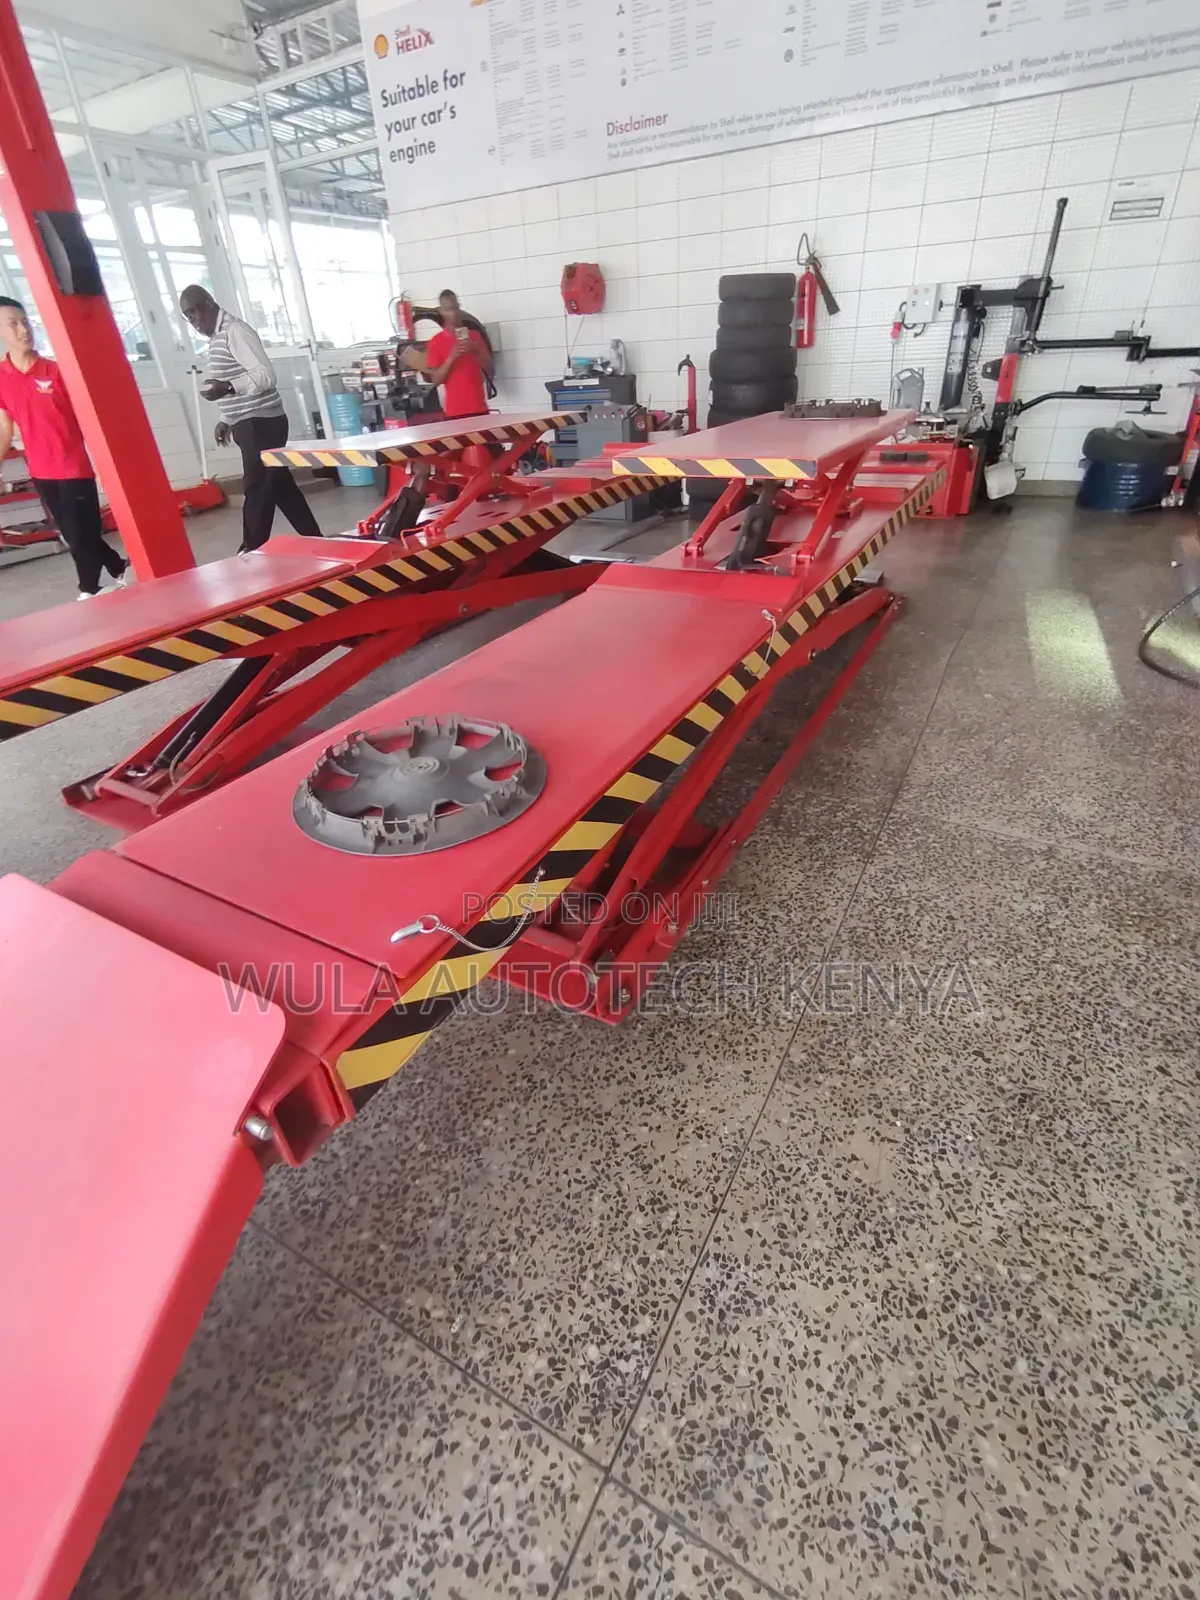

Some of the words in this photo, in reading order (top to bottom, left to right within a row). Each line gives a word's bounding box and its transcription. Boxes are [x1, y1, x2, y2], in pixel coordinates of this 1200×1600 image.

[394, 24, 411, 39] Shell
[396, 28, 435, 55] HELIX
[381, 74, 439, 108] Suitable
[443, 68, 466, 91] for
[384, 115, 417, 142] your
[420, 101, 457, 127] car's
[606, 113, 669, 136] Disclaimer
[389, 138, 436, 164] engine
